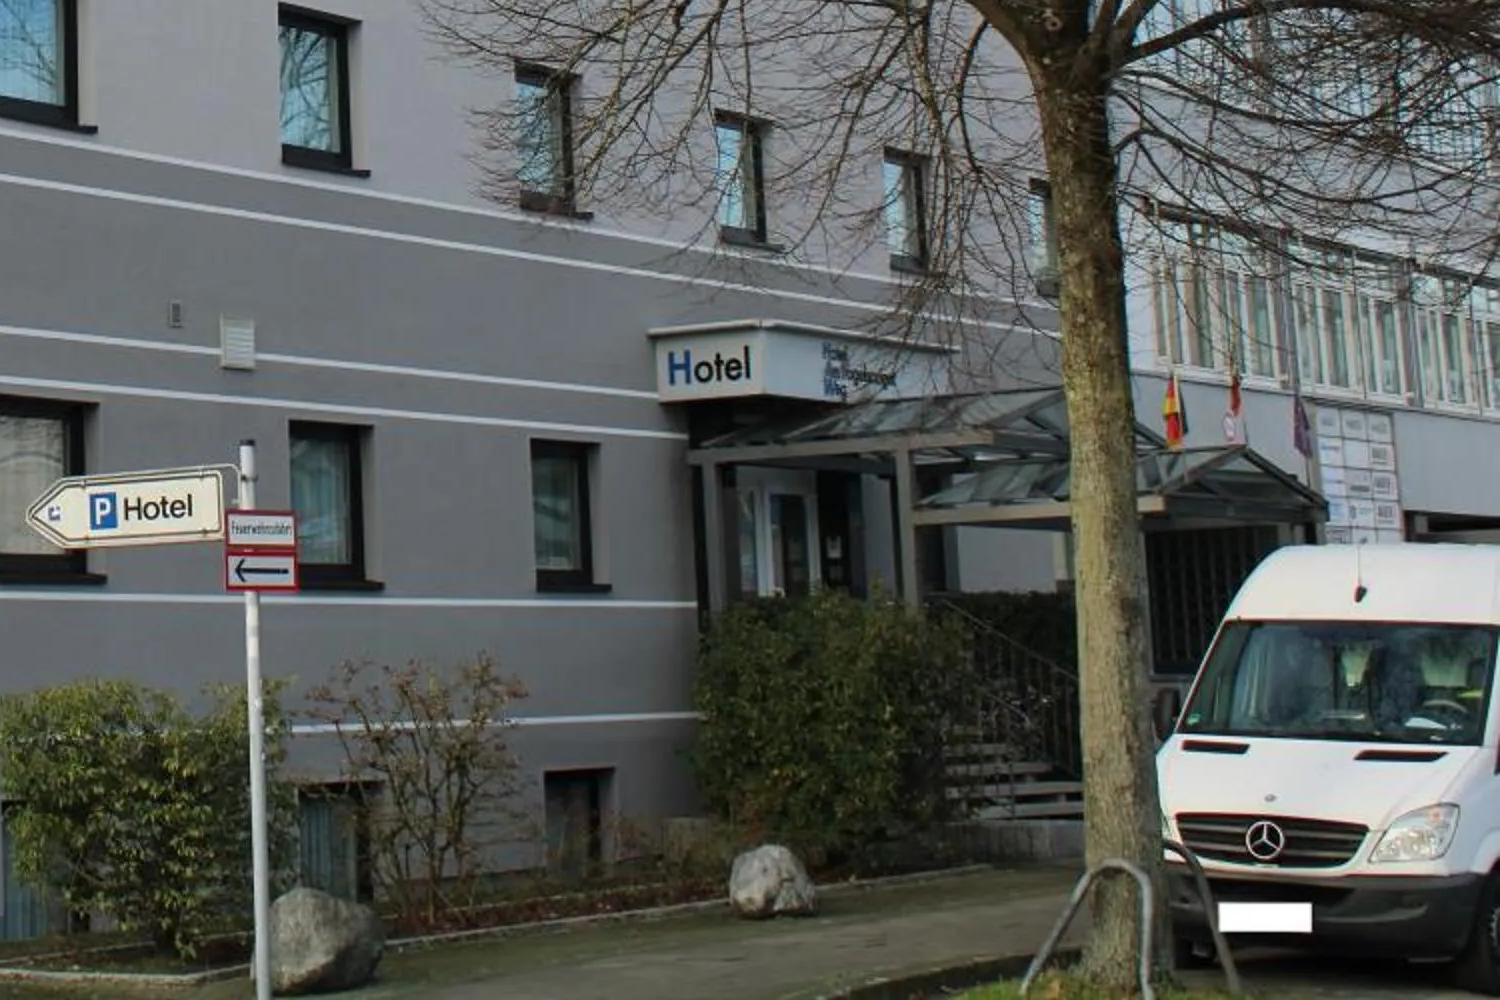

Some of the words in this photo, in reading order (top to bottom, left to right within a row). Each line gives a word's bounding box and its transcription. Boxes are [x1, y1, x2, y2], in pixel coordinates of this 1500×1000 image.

[667, 346, 752, 386] Hotel
[95, 497, 111, 525] P
[123, 493, 193, 521] Hotel
